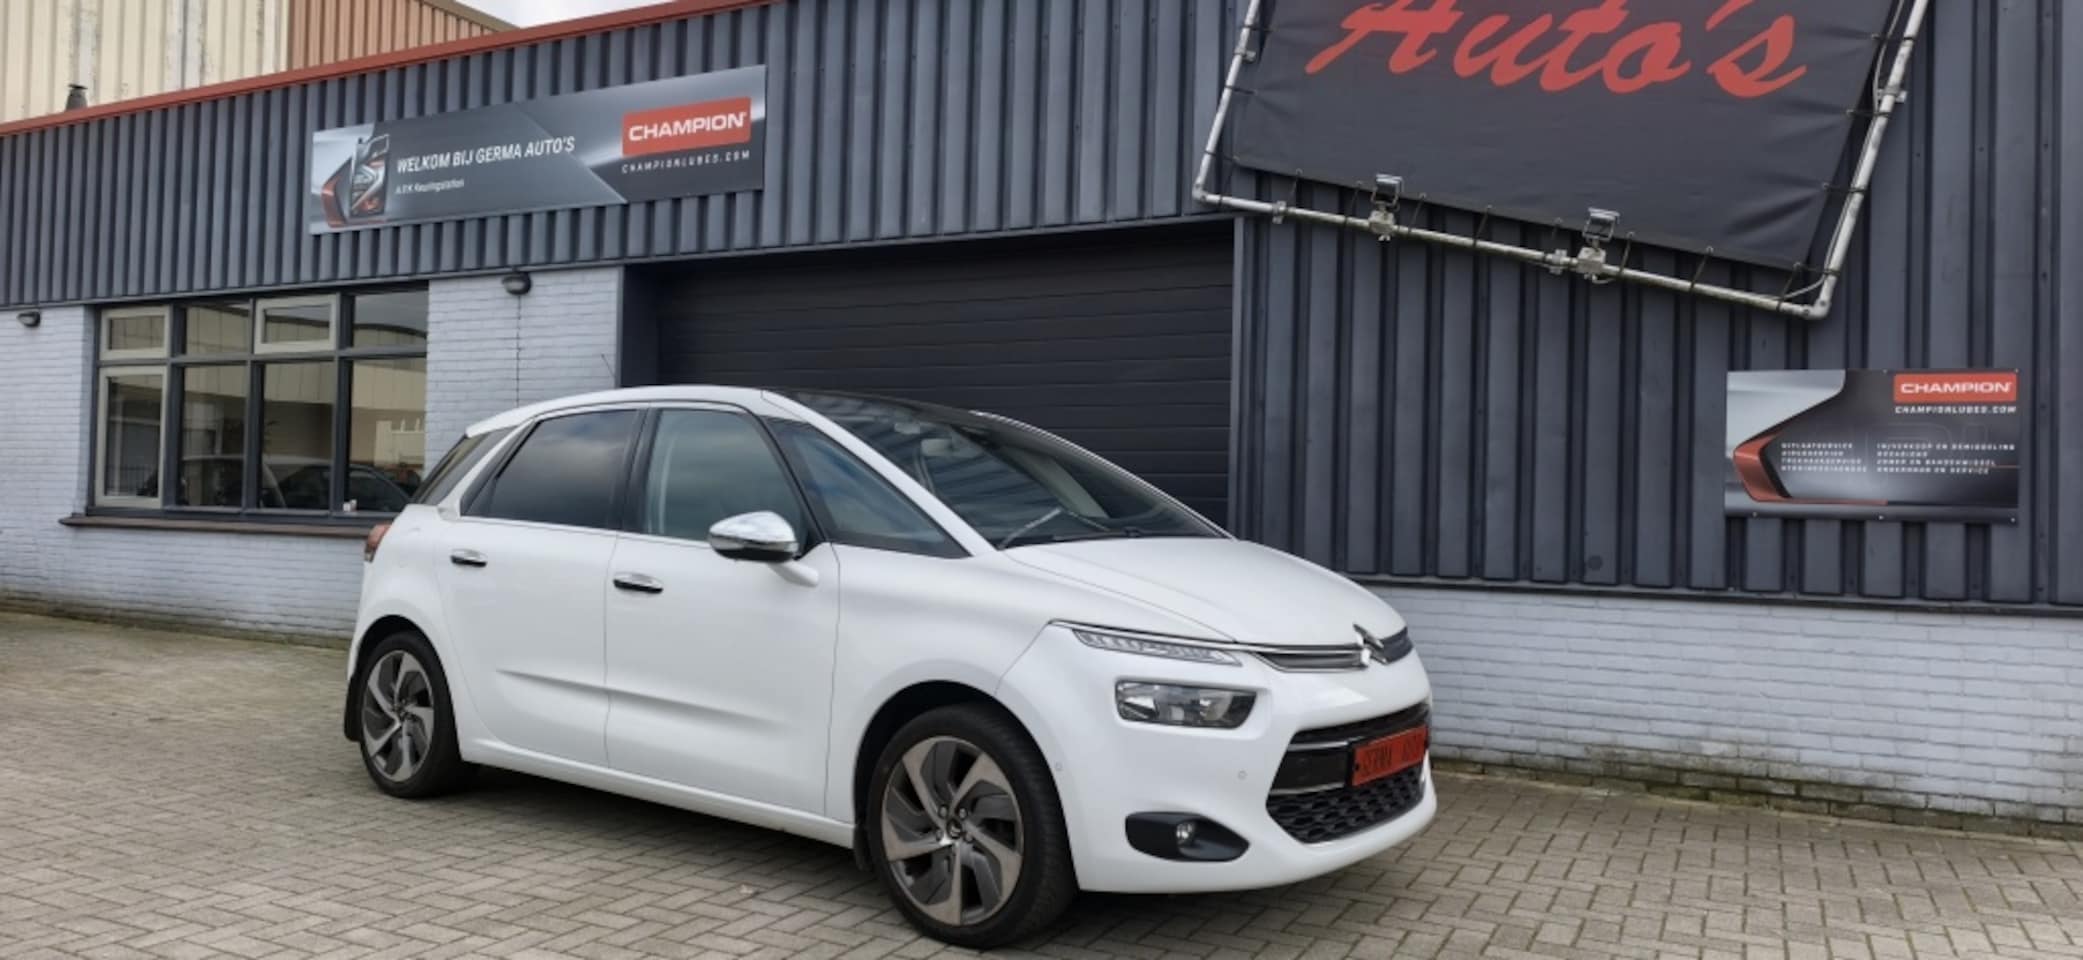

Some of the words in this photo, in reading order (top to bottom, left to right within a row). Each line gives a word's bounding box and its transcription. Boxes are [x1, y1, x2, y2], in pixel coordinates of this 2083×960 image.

[628, 112, 745, 141] CHAMPION
[397, 152, 450, 173] WELKOM
[452, 149, 474, 167] BIJ
[475, 143, 522, 164] GERMA
[524, 136, 576, 157] AUTO'S
[621, 149, 750, 174] CHAMPIONLUBES.COM
[1900, 382, 2012, 394] CHAMPION
[1895, 405, 2017, 414] CHAMPIONLUBES.COM
